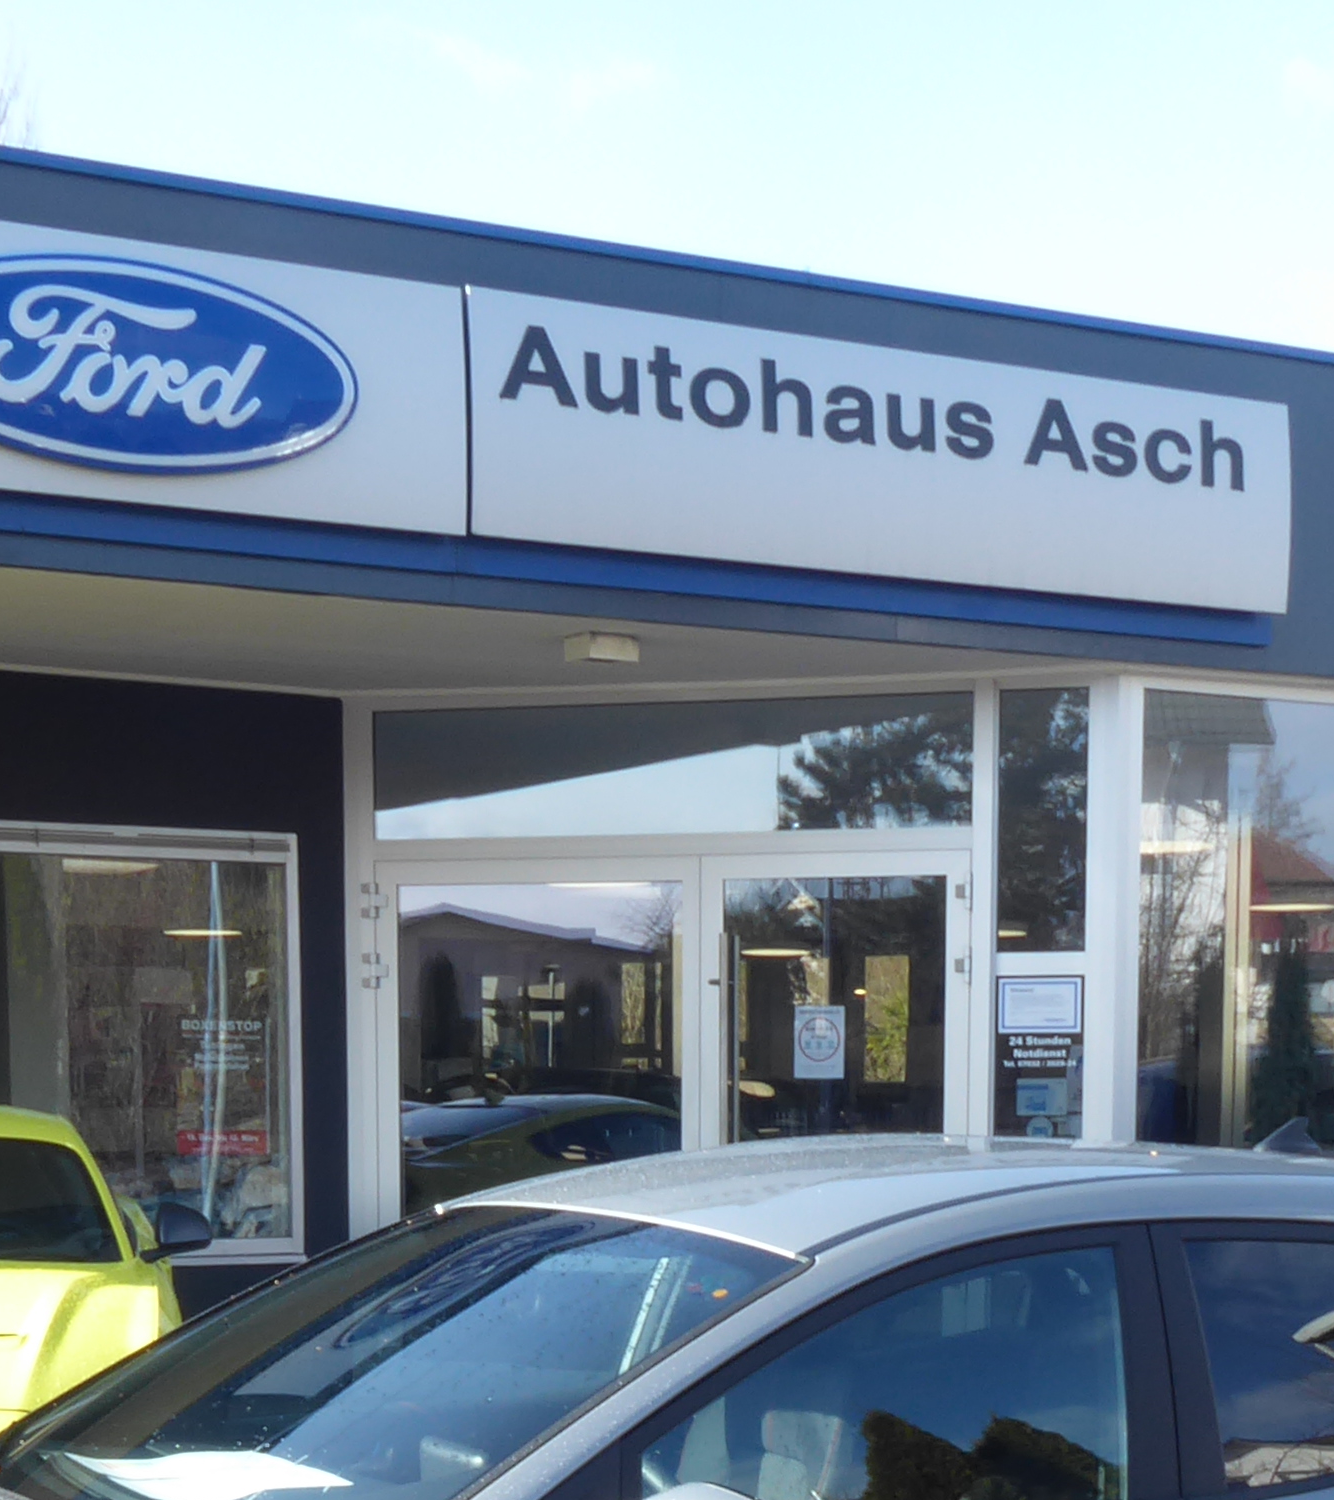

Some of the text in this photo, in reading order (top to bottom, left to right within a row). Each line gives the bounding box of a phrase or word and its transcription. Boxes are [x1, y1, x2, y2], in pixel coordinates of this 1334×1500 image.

[499, 324, 1246, 493] Autohaus Asch
[1008, 1035, 1072, 1047] 24 Stunden
[1012, 1048, 1067, 1059] Notdienst
